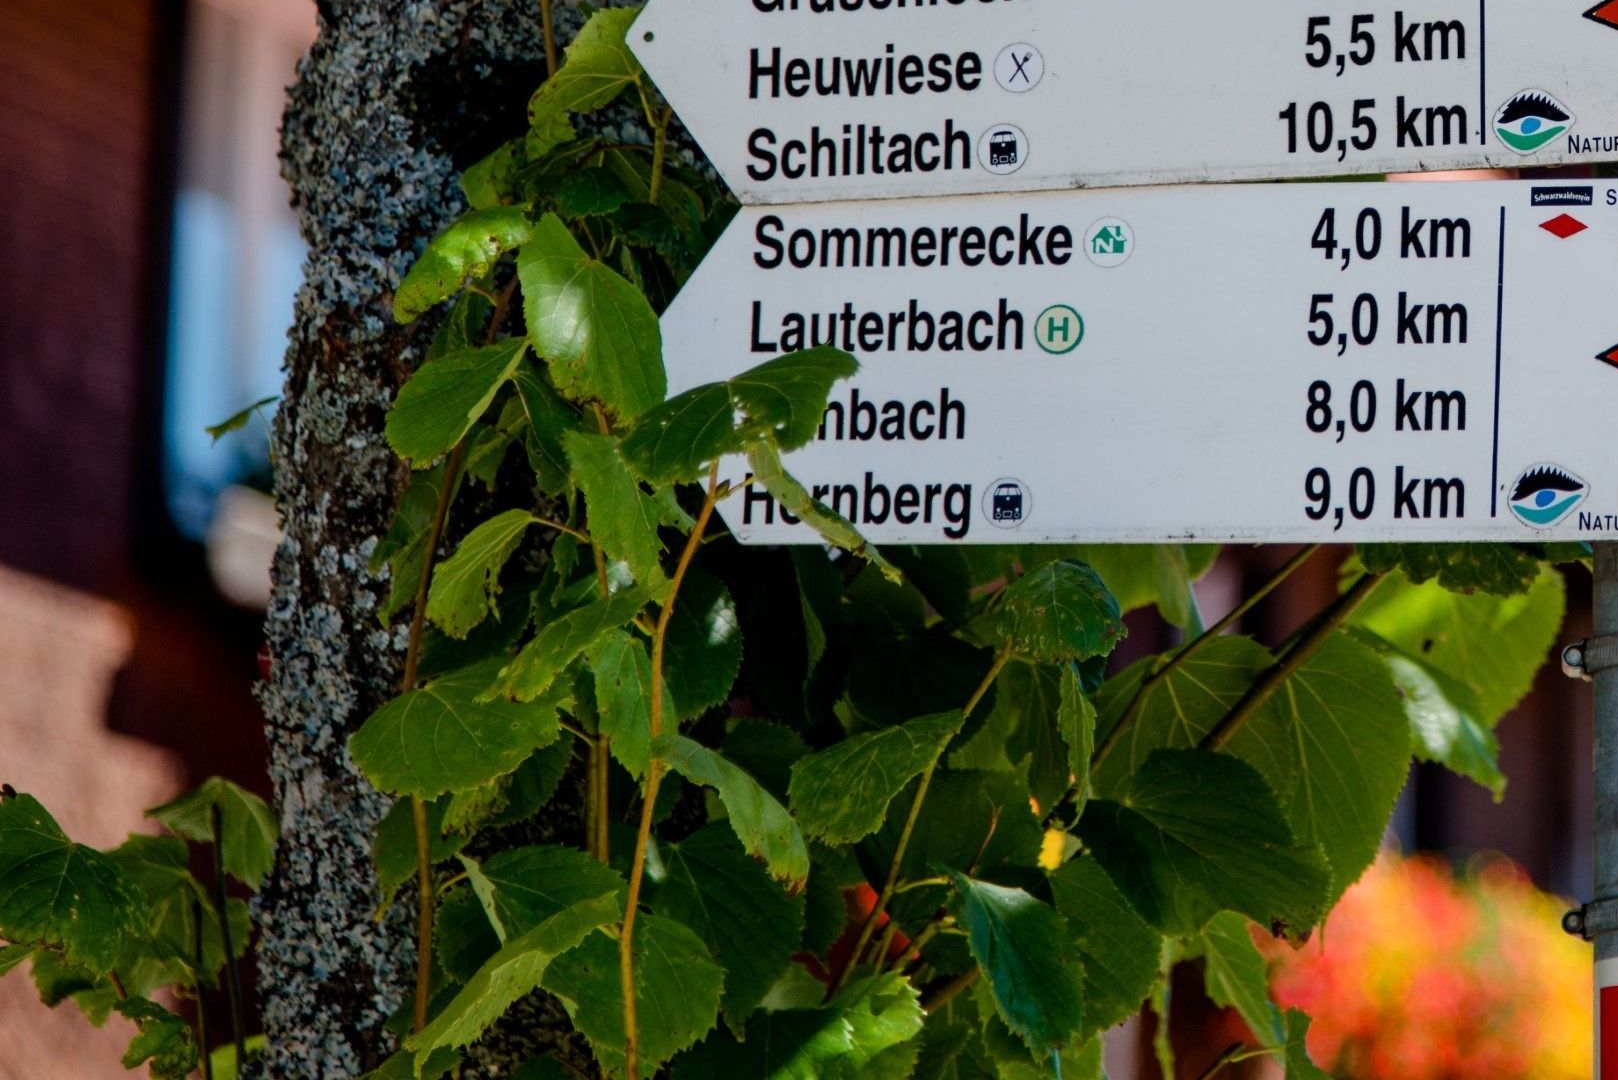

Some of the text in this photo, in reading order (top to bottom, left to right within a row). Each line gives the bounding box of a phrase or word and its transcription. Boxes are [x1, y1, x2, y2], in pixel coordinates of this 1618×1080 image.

[749, 44, 982, 99] Heuwiese
[1305, 11, 1465, 77] 5,5 km
[747, 119, 971, 181] Schiltach
[1279, 95, 1467, 162] 10,5 km
[1534, 192, 1590, 202] Schwarzwaldverein
[754, 214, 1072, 269] Sommerecke
[1311, 206, 1471, 271] 4,0 km
[751, 299, 1023, 352] Lauterbach
[1307, 292, 1467, 356] 5,0 km
[818, 387, 966, 441] nbach
[1306, 378, 1466, 443] 8,0 km
[1305, 465, 1465, 531] 9,0 km
